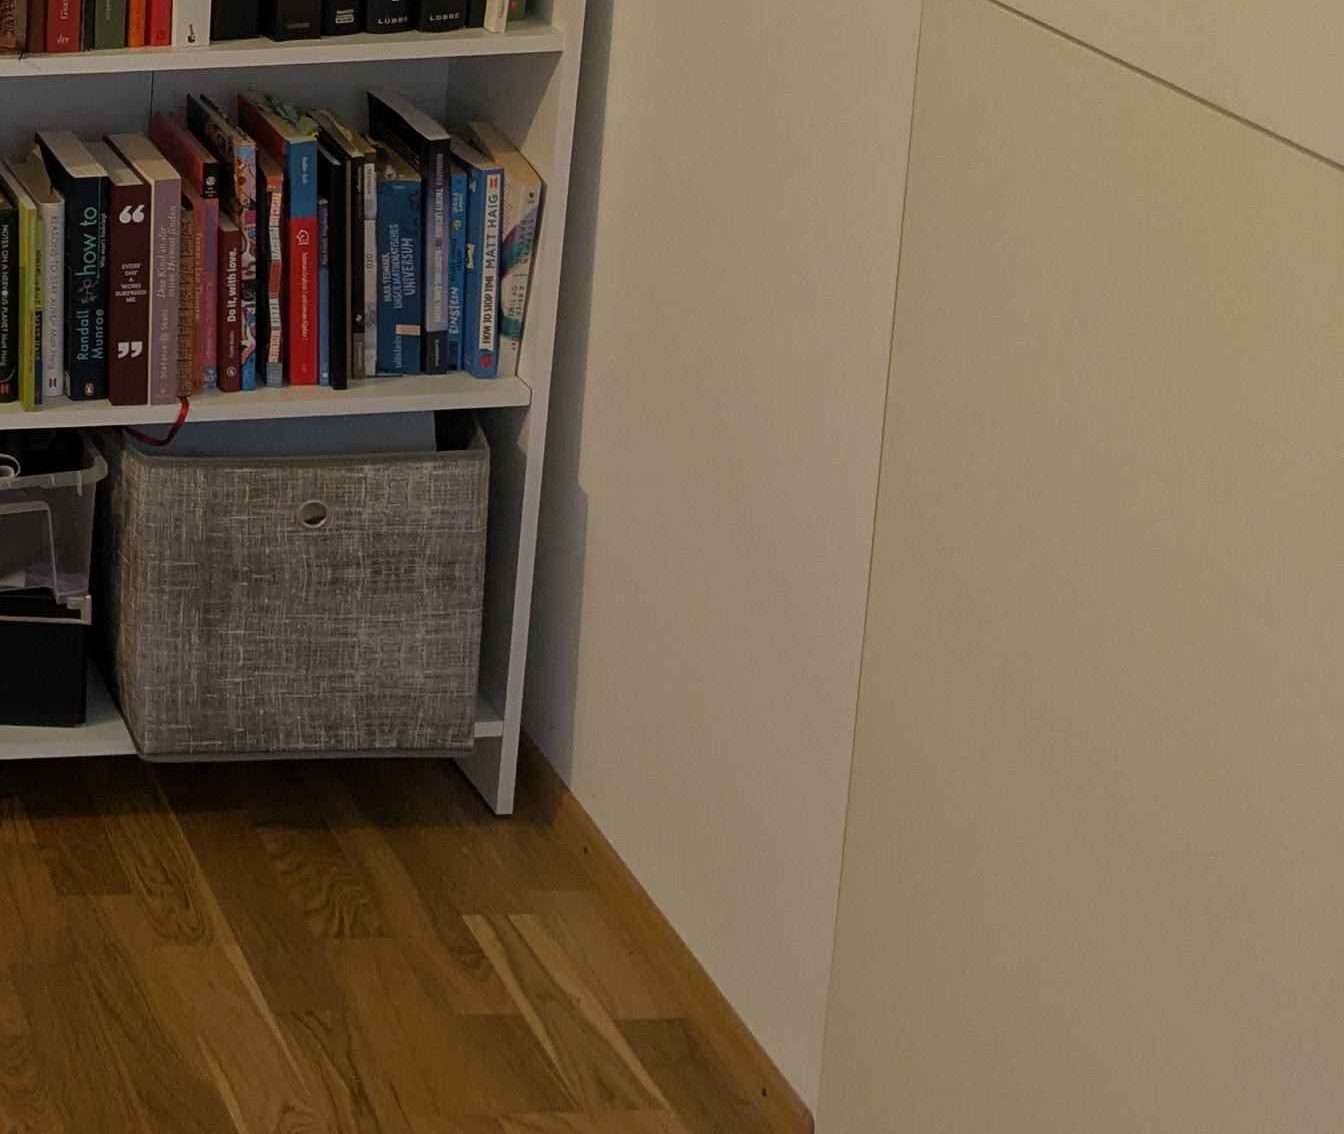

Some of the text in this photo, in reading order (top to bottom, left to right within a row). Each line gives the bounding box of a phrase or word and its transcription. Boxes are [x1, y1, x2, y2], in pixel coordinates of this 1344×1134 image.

[80, 207, 96, 276] how to
[227, 248, 237, 271] love.
[227, 272, 237, 292] with
[483, 195, 499, 343] HOW TO STOP TIME MATT HAIG
[77, 309, 88, 361] Randall
[92, 309, 103, 359] Munroe
[227, 308, 236, 323] Do
